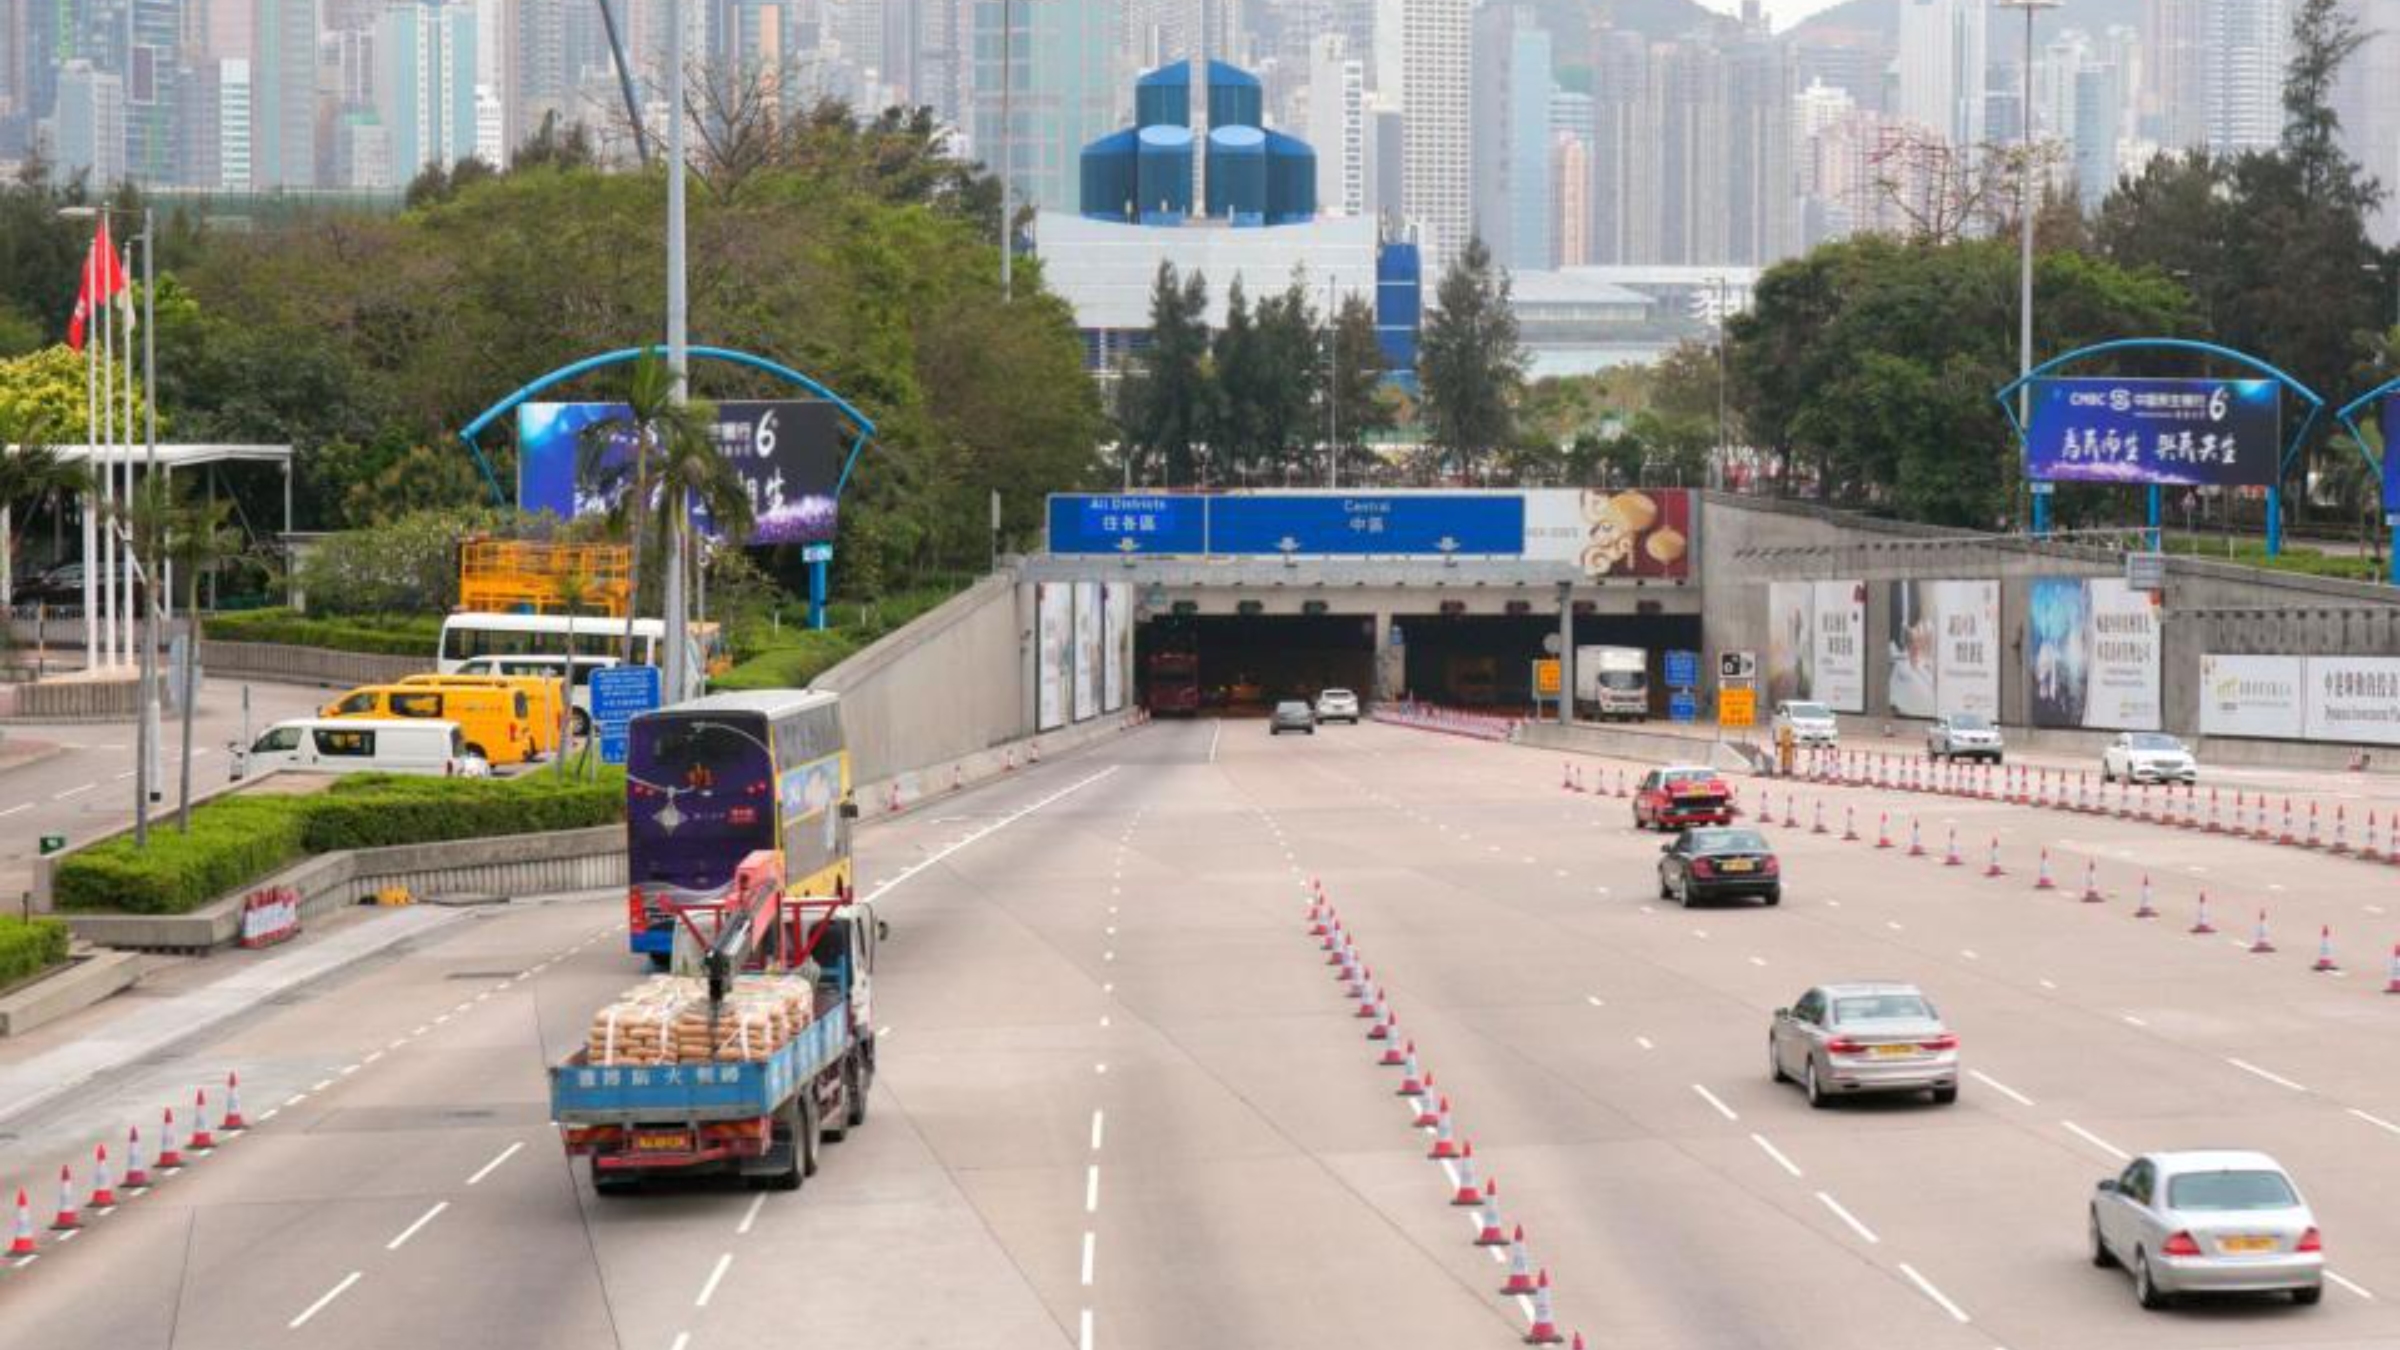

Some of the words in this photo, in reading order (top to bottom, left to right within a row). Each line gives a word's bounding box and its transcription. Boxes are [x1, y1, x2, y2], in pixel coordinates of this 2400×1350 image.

[2069, 391, 2105, 406] CMBC
[1090, 497, 1108, 509] All
[1112, 497, 1166, 510] Districts
[1344, 499, 1391, 513] Central
[1102, 514, 1156, 531] 往各區
[1349, 517, 1384, 534] 中區
